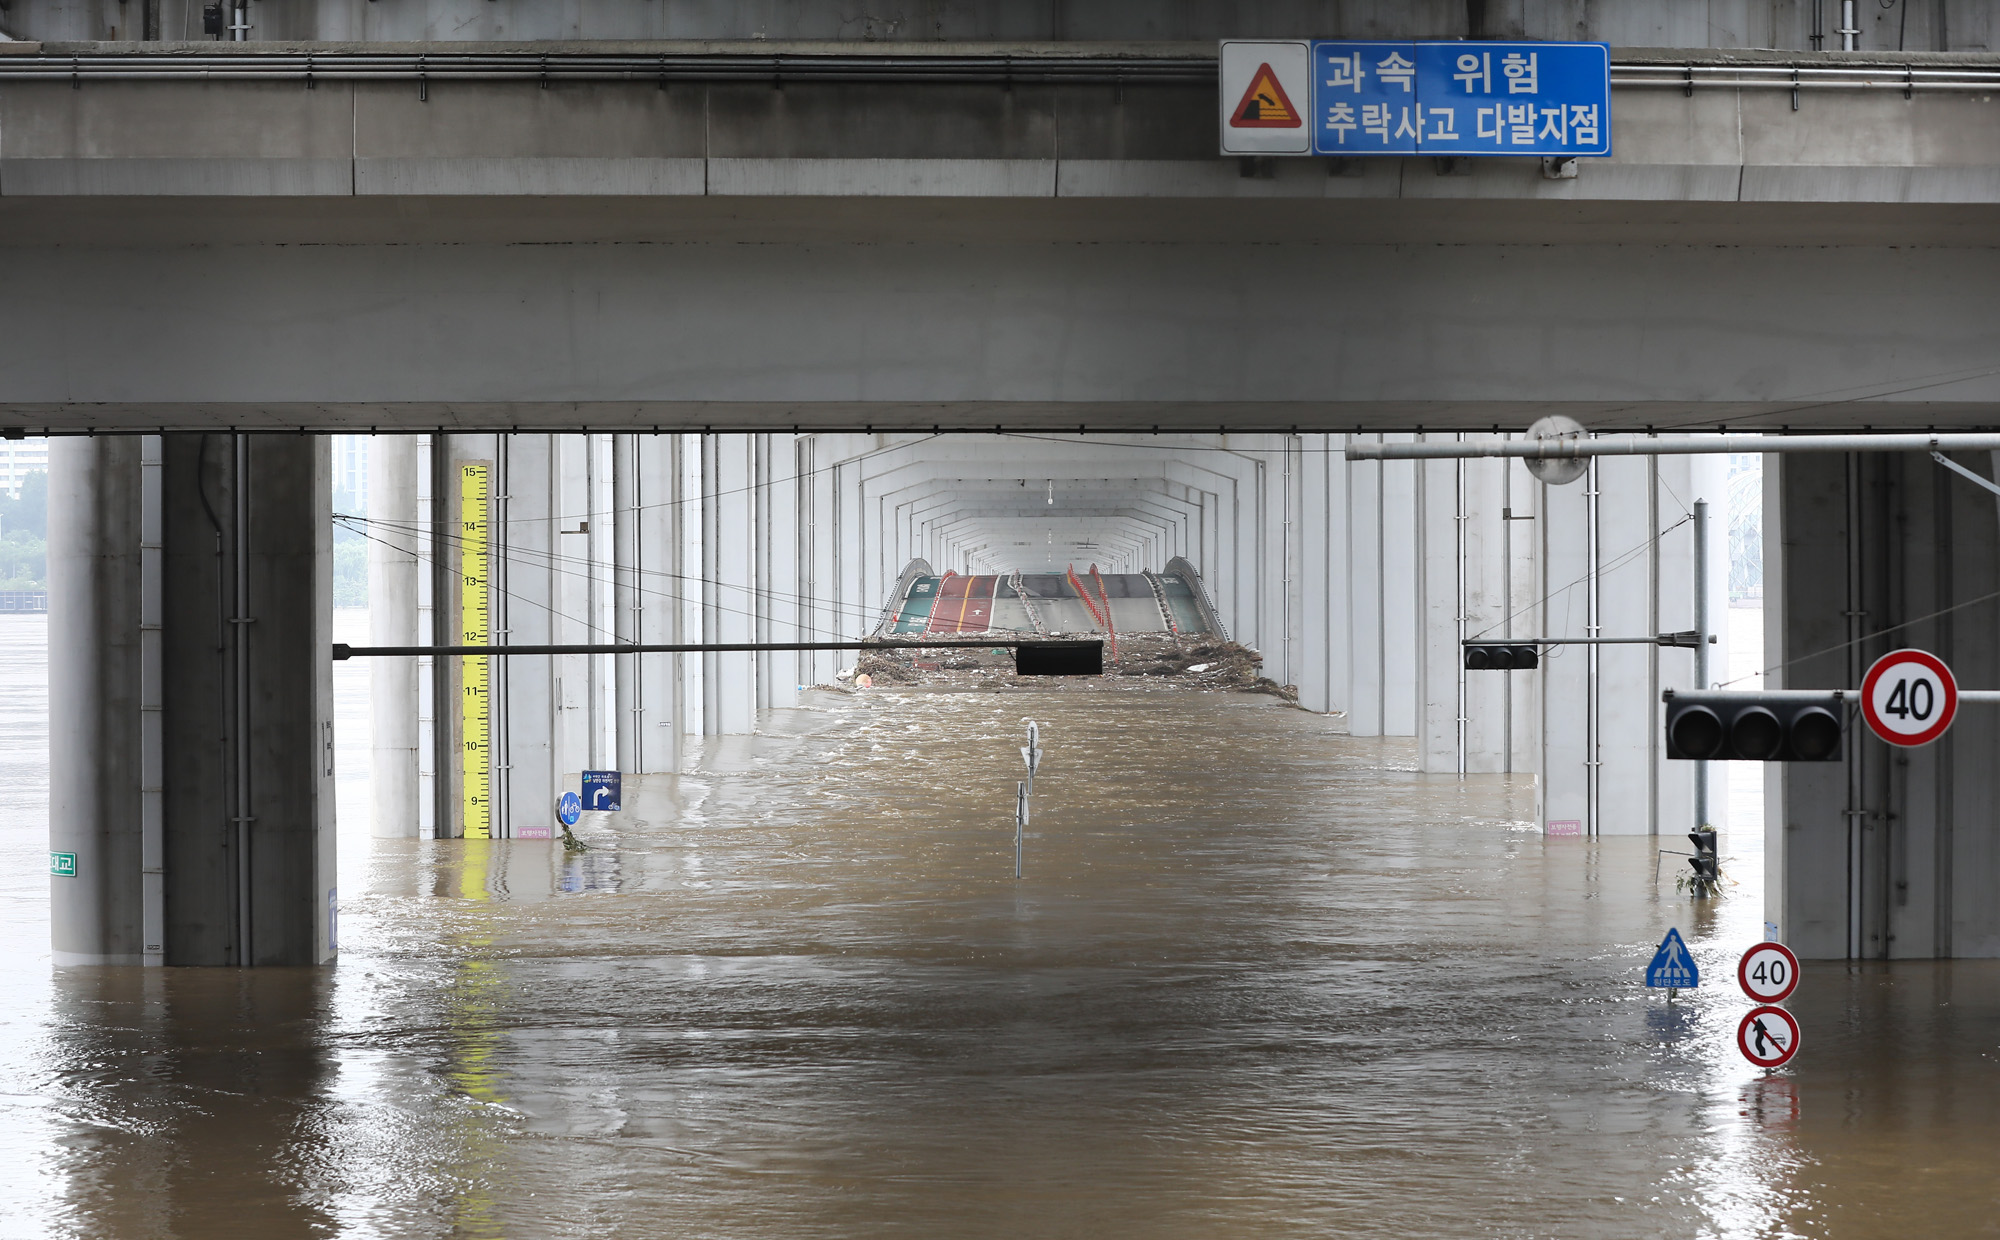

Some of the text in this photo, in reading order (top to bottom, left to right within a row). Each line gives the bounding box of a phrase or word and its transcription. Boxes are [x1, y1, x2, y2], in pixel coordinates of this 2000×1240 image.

[1326, 52, 1539, 94] 과속 위험
[1326, 102, 1599, 145] 추락사고 다발지점
[464, 467, 476, 477] 15
[464, 522, 476, 531] 14
[464, 577, 477, 586] 13
[464, 632, 477, 641] 12
[465, 687, 478, 696] 11
[1885, 678, 1934, 720] 40
[465, 741, 478, 751] 10
[471, 796, 478, 805] 9
[1752, 960, 1785, 985] 40
